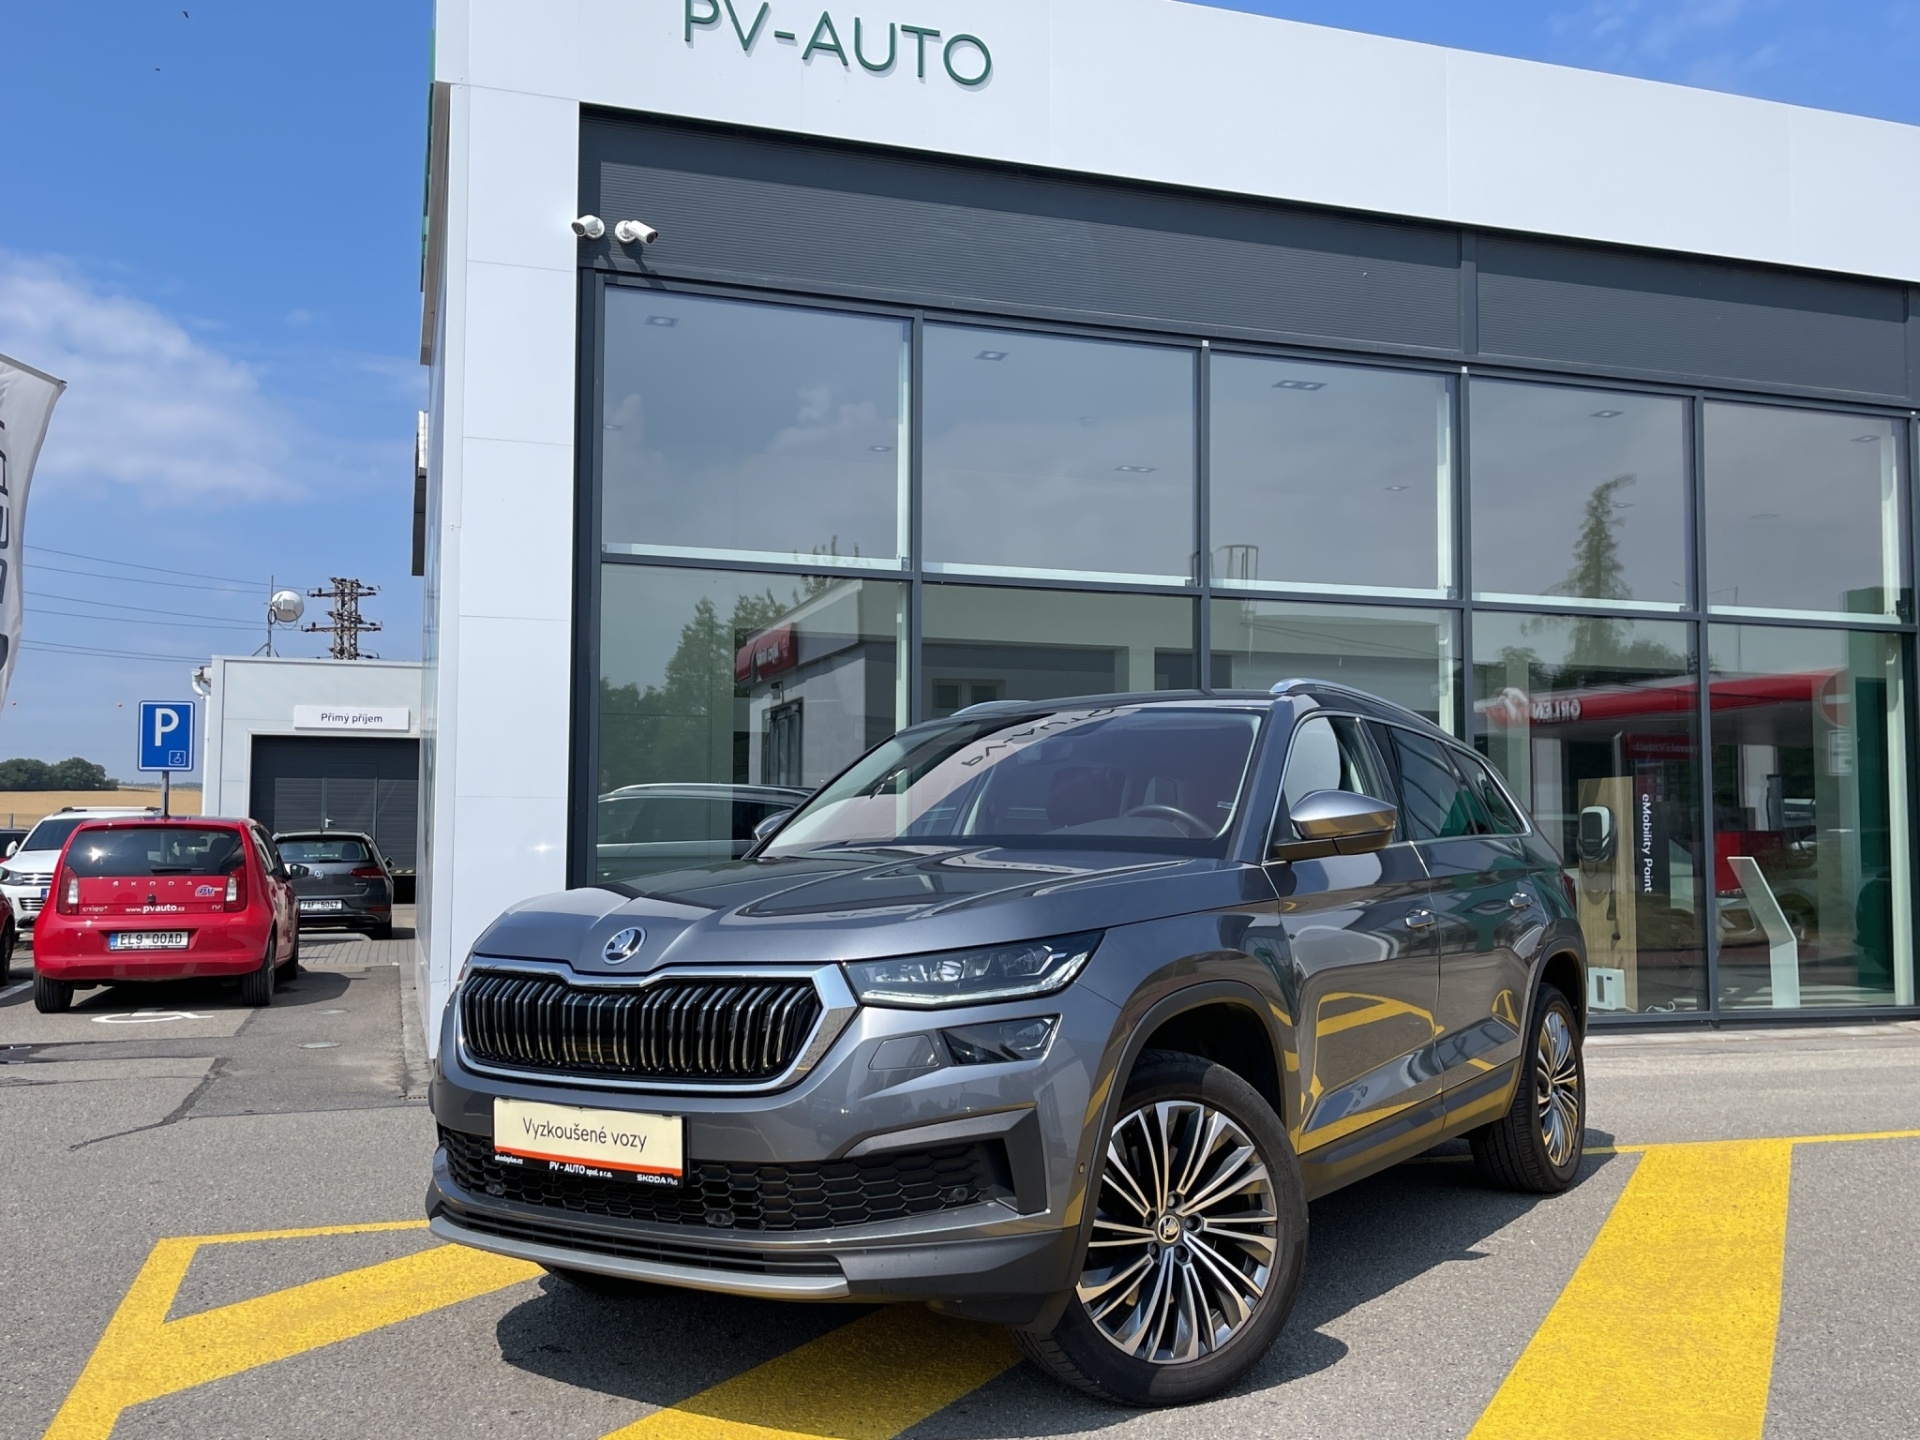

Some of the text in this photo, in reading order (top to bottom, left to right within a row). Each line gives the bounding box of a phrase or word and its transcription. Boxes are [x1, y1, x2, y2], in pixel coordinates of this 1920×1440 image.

[685, 0, 992, 85] PV-AUTO
[154, 708, 179, 747] P
[1641, 793, 1654, 893] eMobility Point
[125, 904, 186, 914] www.pvauto.cz
[120, 933, 143, 945] EL9
[523, 1117, 647, 1153] Vyzkoušené vozy
[563, 1164, 585, 1174] AUTO
